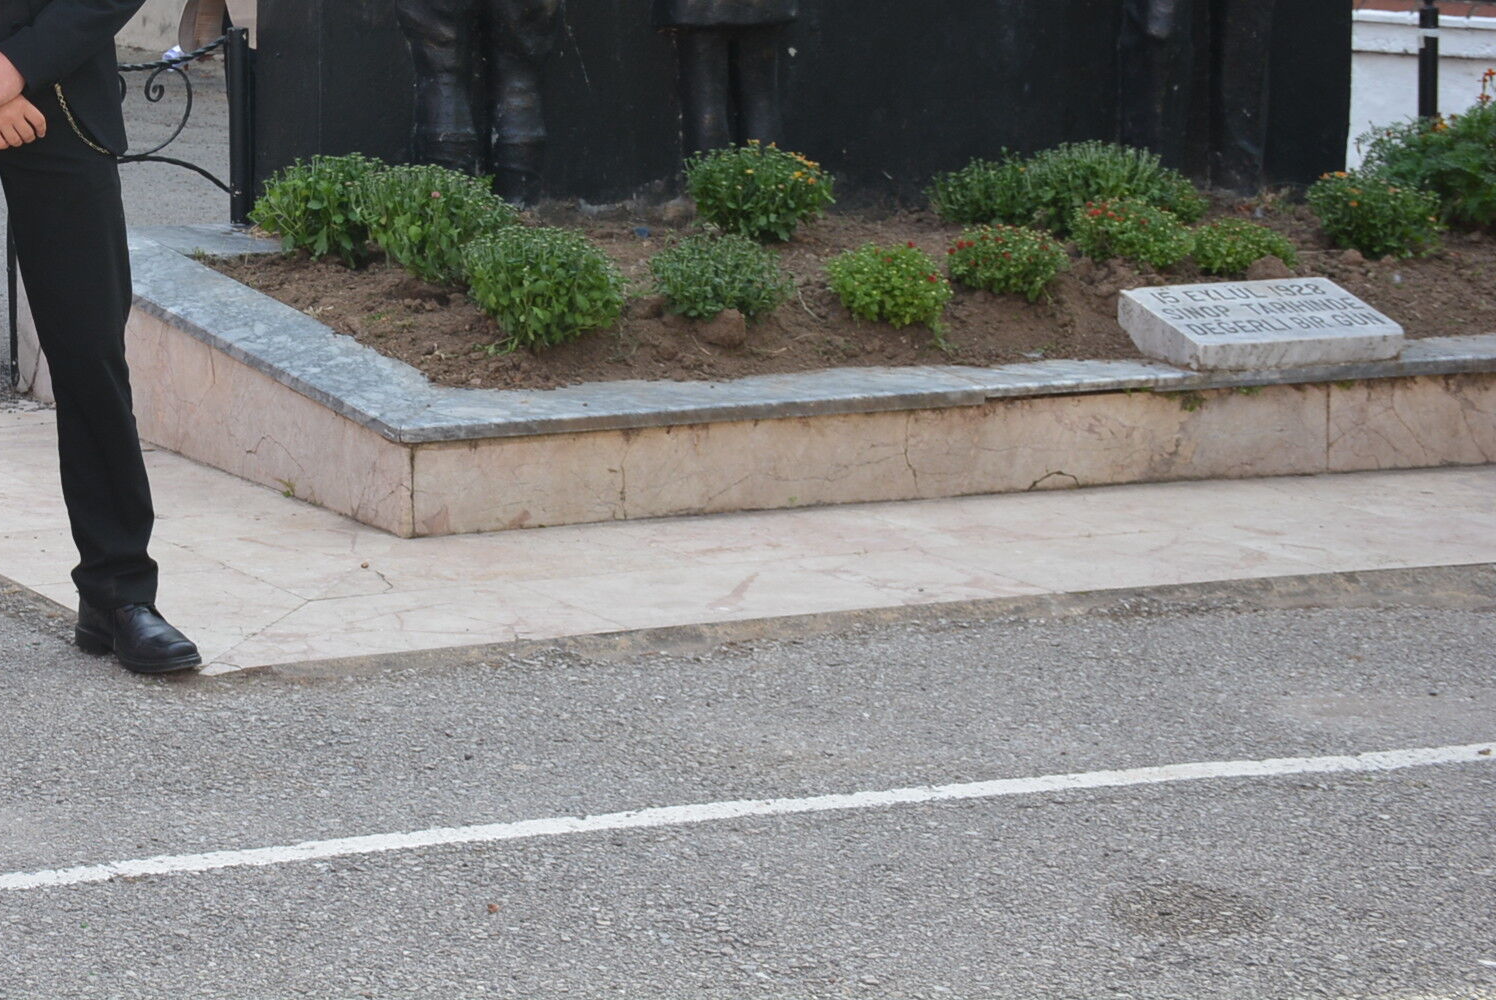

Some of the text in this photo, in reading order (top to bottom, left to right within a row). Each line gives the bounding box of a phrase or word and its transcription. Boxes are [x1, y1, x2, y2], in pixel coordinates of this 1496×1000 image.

[1149, 283, 1327, 304] 15 EYLÜL 1928
